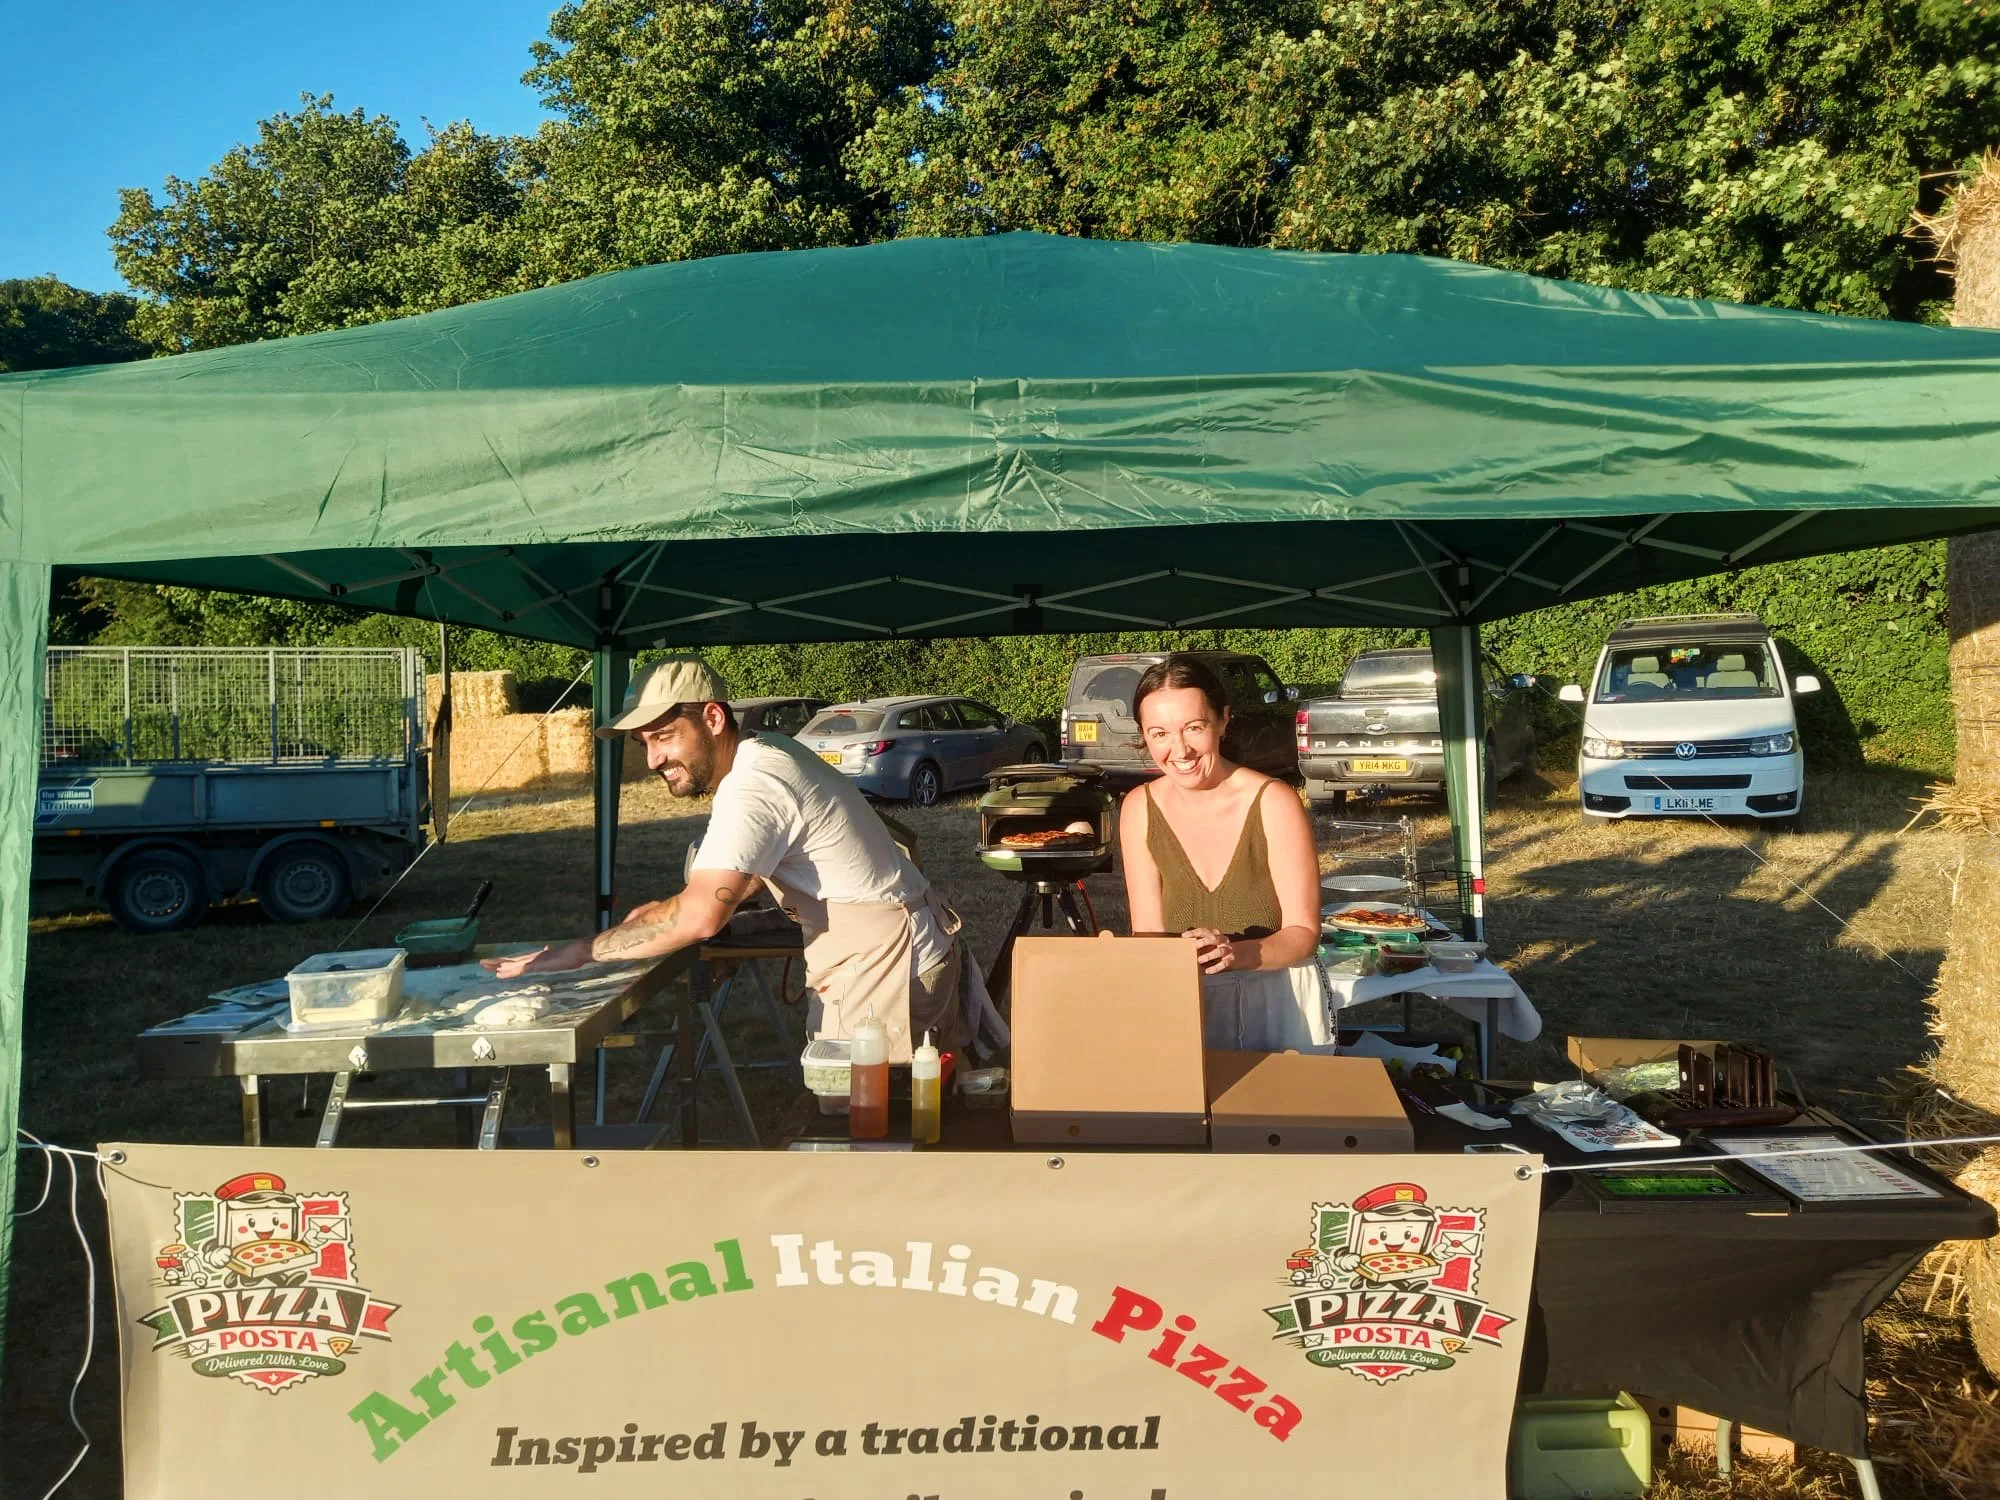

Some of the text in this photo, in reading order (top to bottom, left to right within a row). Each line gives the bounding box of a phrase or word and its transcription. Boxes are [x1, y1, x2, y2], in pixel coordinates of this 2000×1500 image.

[42, 801, 90, 810] Trailers
[185, 1287, 348, 1332] PIZZA
[1307, 1291, 1463, 1333] PIZZA
[219, 1330, 319, 1352] POSTA
[347, 1234, 1303, 1464] Artisanal Italian Pizza
[1334, 1327, 1432, 1349] POSTA
[206, 1354, 329, 1371] Delivered With Love
[1319, 1347, 1439, 1366] Delivered With Love
[490, 1414, 1161, 1474] Inspired by a traditional
